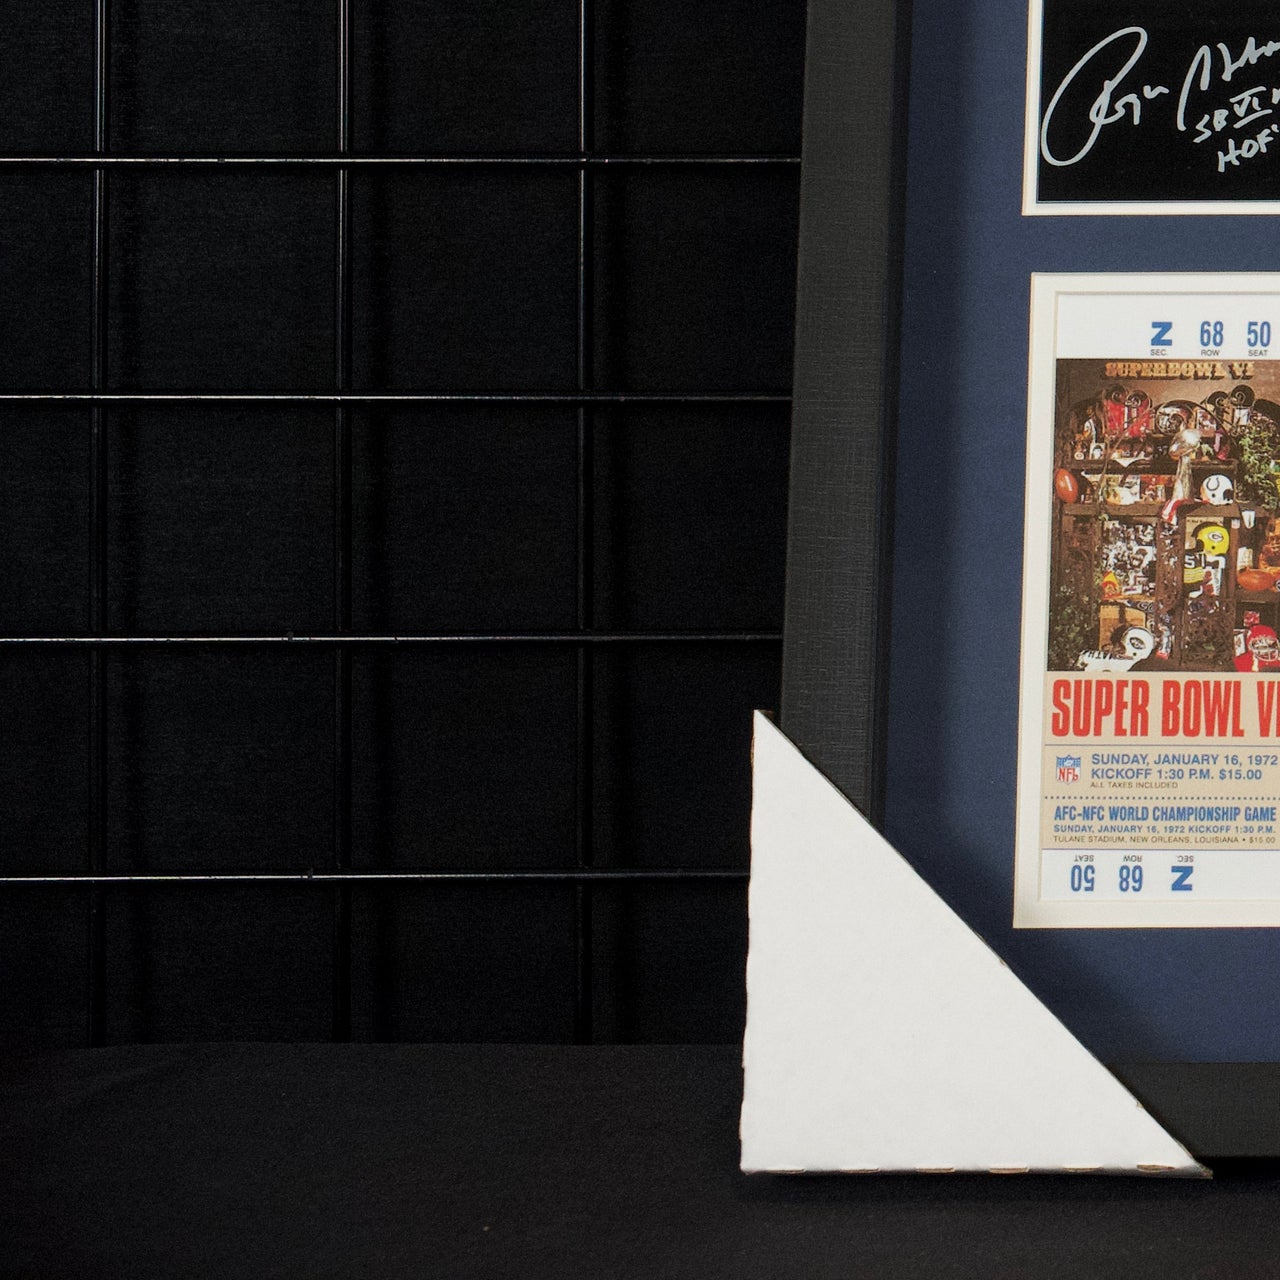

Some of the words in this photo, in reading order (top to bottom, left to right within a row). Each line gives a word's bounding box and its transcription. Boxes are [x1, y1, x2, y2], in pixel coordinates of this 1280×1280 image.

[1151, 322, 1172, 346] Z
[1200, 321, 1224, 346] 68
[1247, 321, 1271, 346] 50
[1051, 679, 1150, 737] SUPER
[1161, 680, 1244, 737] BOWL
[1091, 754, 1149, 766] SUNDAY,
[1154, 754, 1219, 765] JANUARY
[1224, 755, 1242, 766] 16,
[1249, 755, 1278, 766] 1972
[1059, 768, 1079, 781] NFL
[1054, 806, 1104, 820] AFC-NFC
[1109, 806, 1149, 821] WORLD
[1153, 807, 1240, 821] CHAMPIONSHIP
[1245, 807, 1276, 822] GAME
[1071, 865, 1095, 892] 50
[1119, 865, 1143, 892] 68
[1171, 866, 1194, 891] Z
